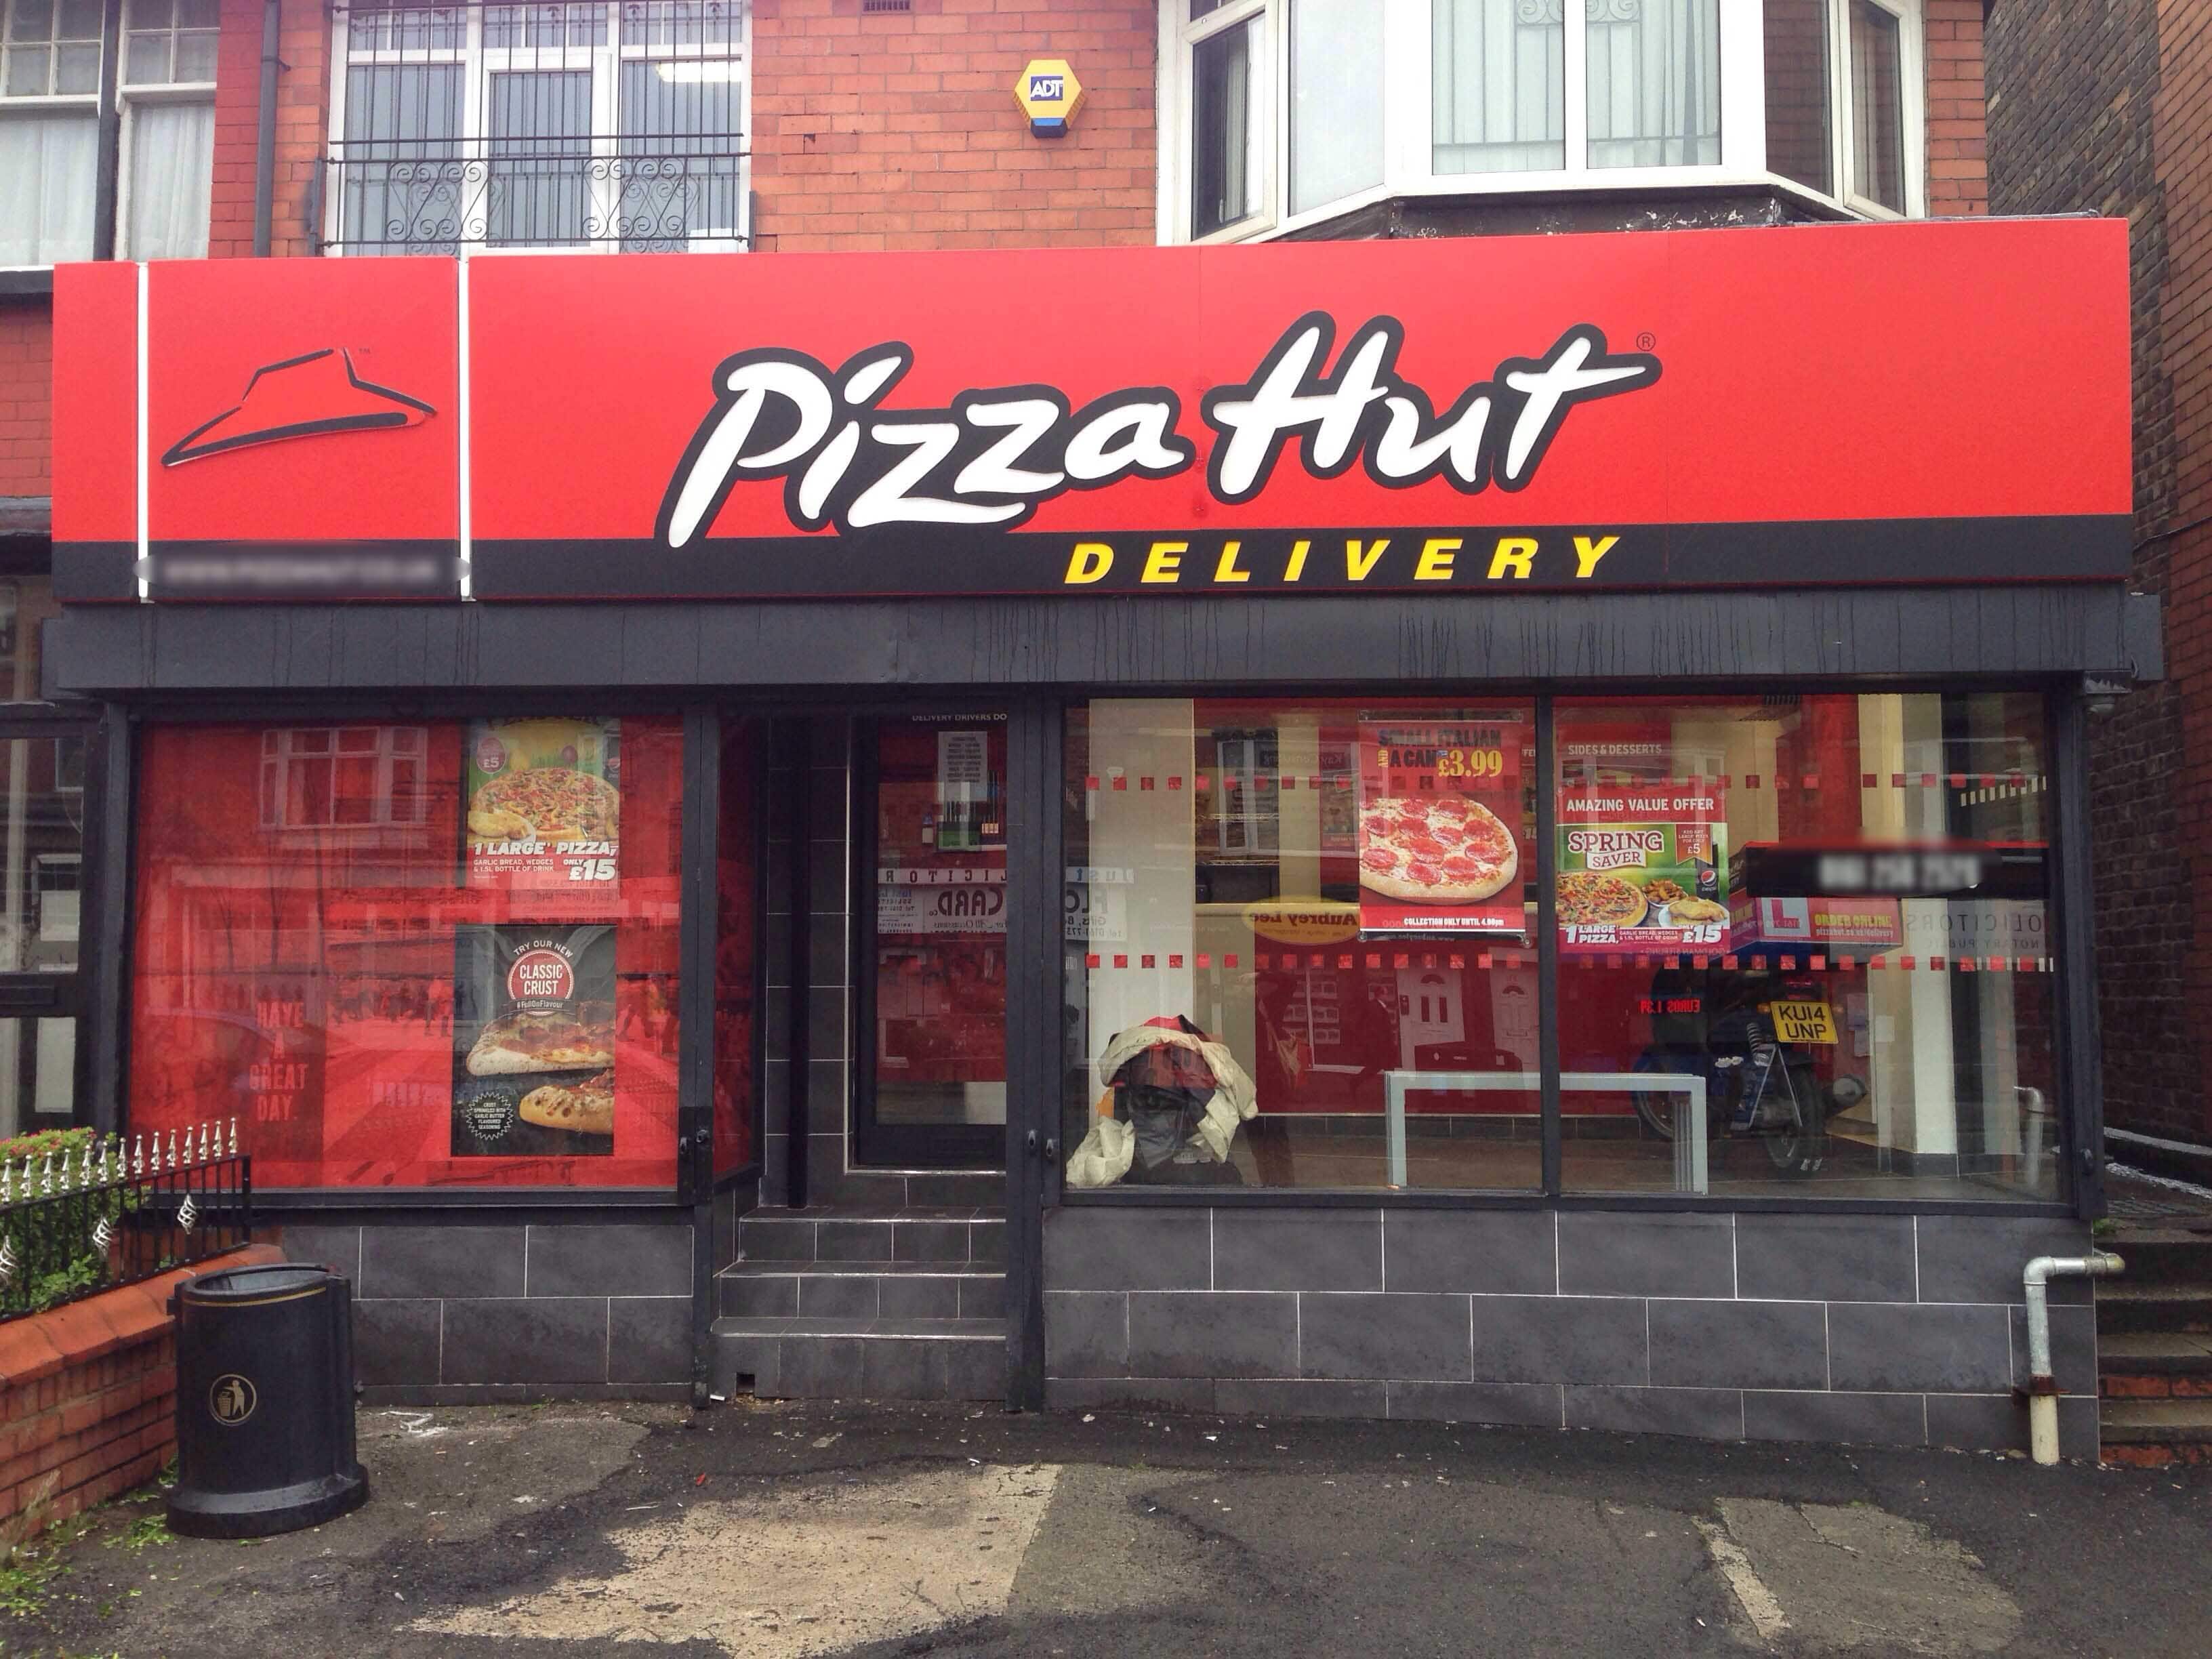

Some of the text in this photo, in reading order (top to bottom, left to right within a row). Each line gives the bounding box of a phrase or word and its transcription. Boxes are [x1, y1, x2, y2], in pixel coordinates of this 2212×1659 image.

[1030, 79, 1063, 98] ADT
[667, 354, 1187, 548] Pizza
[1212, 325, 1647, 495] Hut
[1064, 537, 1621, 584] DELIVERY
[954, 714, 991, 722] DRIVERS
[993, 712, 1008, 721] DO
[1391, 749, 1401, 768] A
[1568, 744, 1662, 755] SIDES & DESSERTS
[483, 757, 499, 769] £5
[1438, 748, 1503, 778] £3.99
[1567, 798, 1714, 812] AMAZING VALUE OFFER
[475, 842, 483, 855] 1
[1568, 830, 1664, 853] SPRING
[1687, 843, 1700, 855] £5
[499, 859, 524, 867] BREAD,
[1593, 851, 1641, 867] SAVER
[569, 859, 616, 881] £15
[1771, 899, 1800, 928] L
[1815, 914, 1852, 927] ORDER
[1853, 914, 1893, 928] ONLINE
[1566, 925, 1578, 943] 1
[1683, 924, 1722, 944] £15
[513, 939, 574, 958] TRY OUR NEW
[520, 964, 563, 980] CLASSIC
[524, 980, 559, 996] CRUST
[255, 1001, 304, 1028] HAVE
[1778, 1004, 1826, 1021] KU14
[1785, 1023, 1827, 1040] UNP
[274, 1032, 285, 1059] A
[249, 1063, 308, 1090] GREAT
